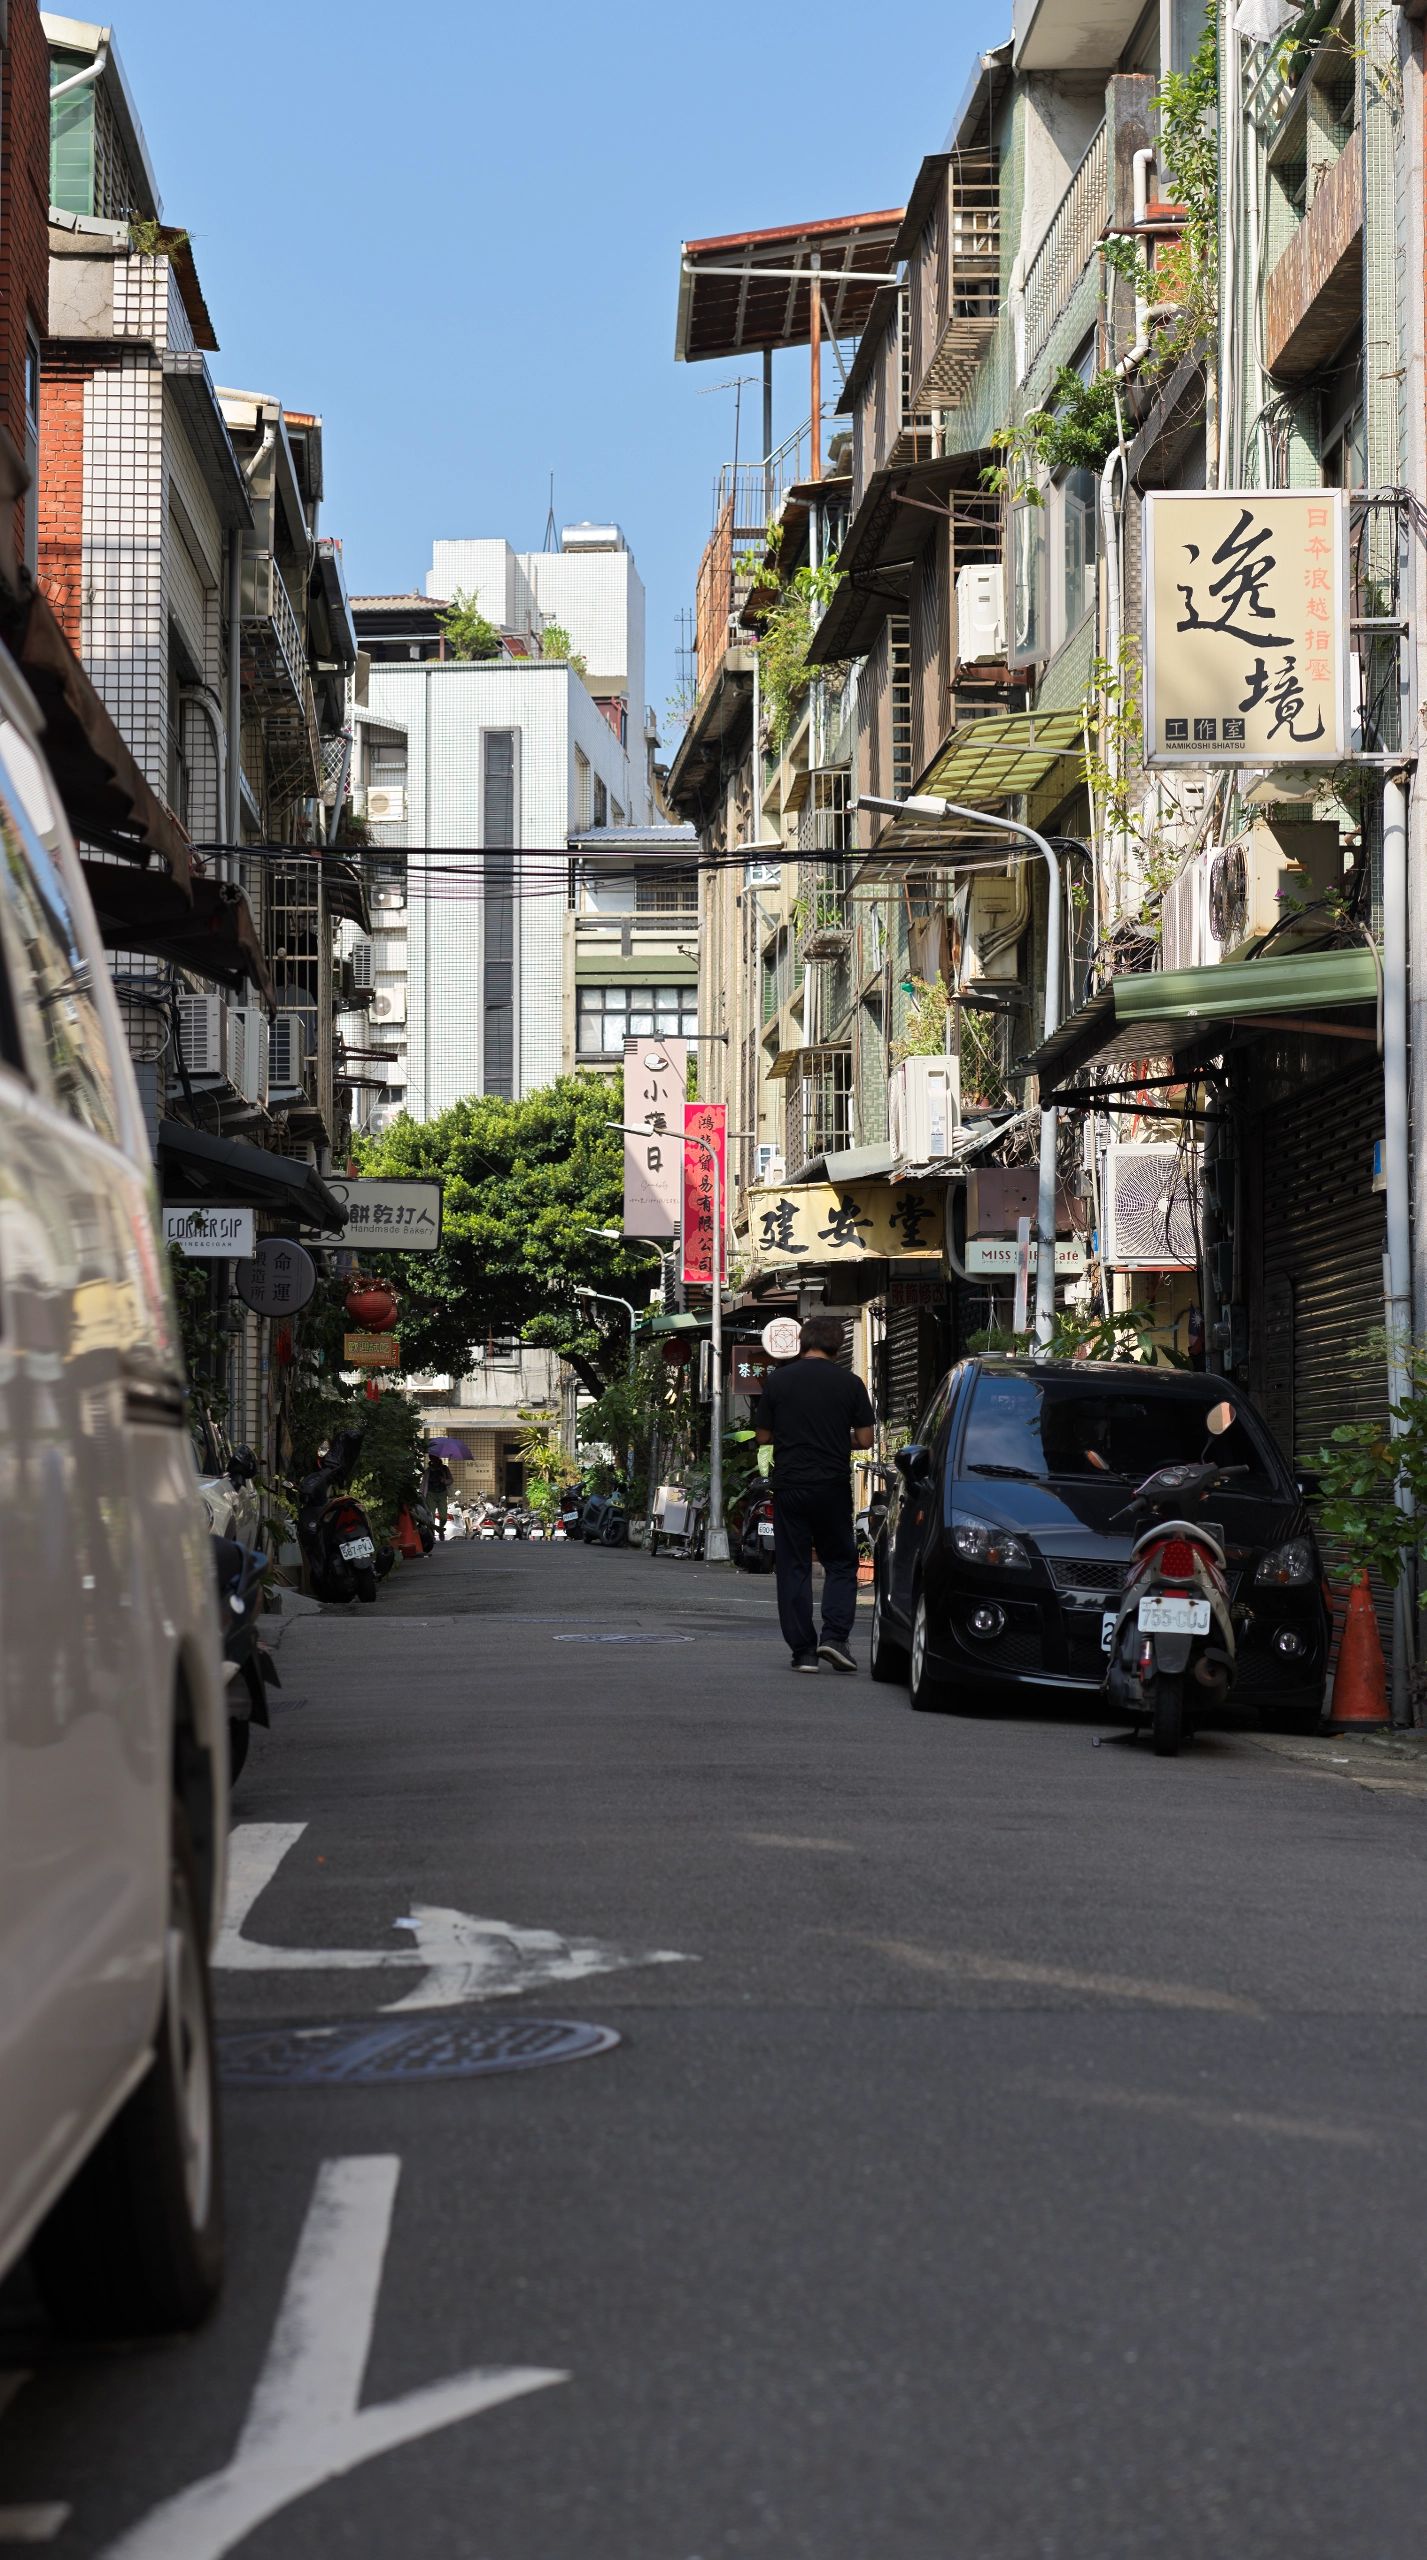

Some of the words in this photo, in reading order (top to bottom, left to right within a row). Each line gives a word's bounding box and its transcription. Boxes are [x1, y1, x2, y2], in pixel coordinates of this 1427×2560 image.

[1304, 508, 1331, 681] 日本浪越指壓
[1166, 719, 1245, 740] 工作室
[345, 1203, 436, 1227] 餅乾打人
[758, 1192, 936, 1254] 建安堂
[220, 1218, 242, 1238] SIP
[350, 1224, 400, 1233] Handmade
[403, 1225, 434, 1235] Bakery
[981, 1250, 1011, 1260] MISS
[272, 1252, 292, 1301] 命運
[891, 1282, 946, 1305] 服飾修改
[342, 1541, 373, 1557] 587-PVJ
[1141, 1608, 1208, 1629] 755-CUJ
